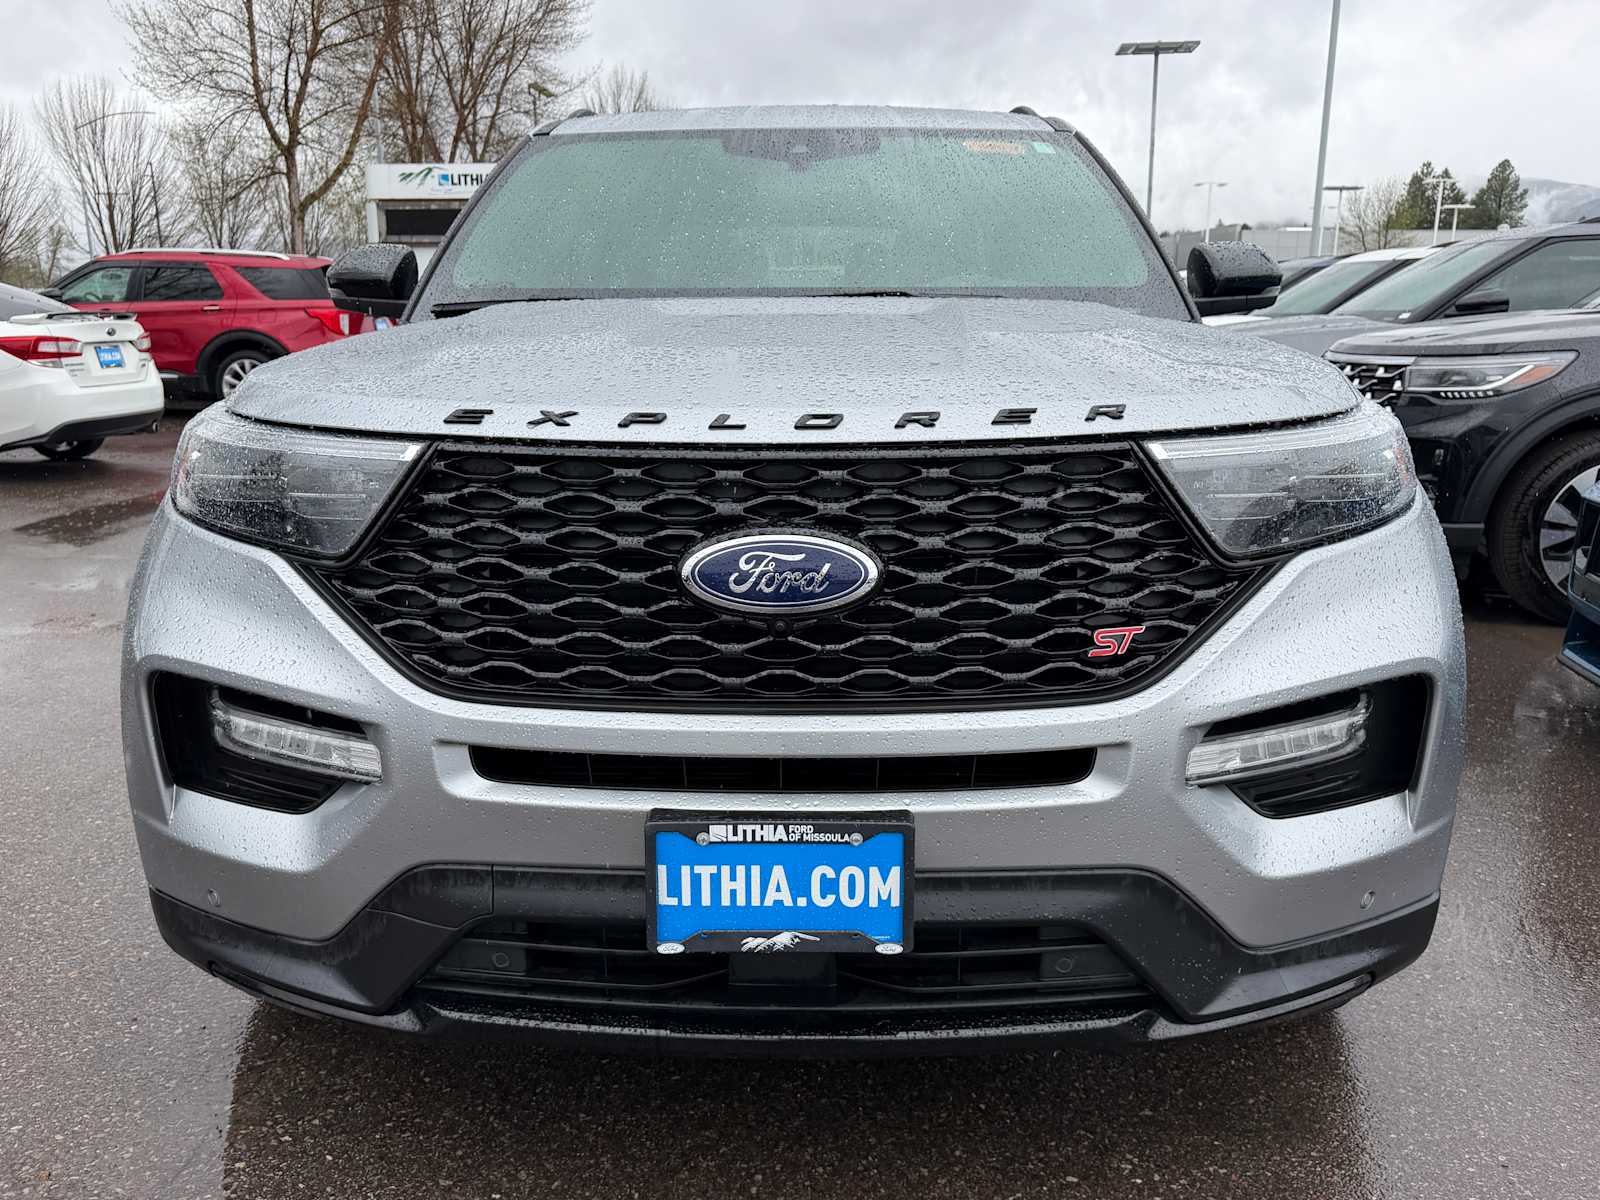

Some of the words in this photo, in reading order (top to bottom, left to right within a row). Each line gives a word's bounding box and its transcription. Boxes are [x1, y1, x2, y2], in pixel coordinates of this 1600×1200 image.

[450, 174, 489, 186] LITHI
[443, 404, 1126, 431] EXPLORER
[728, 551, 832, 594] Ford
[1088, 625, 1146, 657] ST
[727, 824, 788, 842] LITHIA
[788, 825, 814, 834] FORD
[788, 833, 801, 842] OF
[803, 833, 850, 842] MISSOULA
[657, 864, 901, 908] LITHIA.COM
